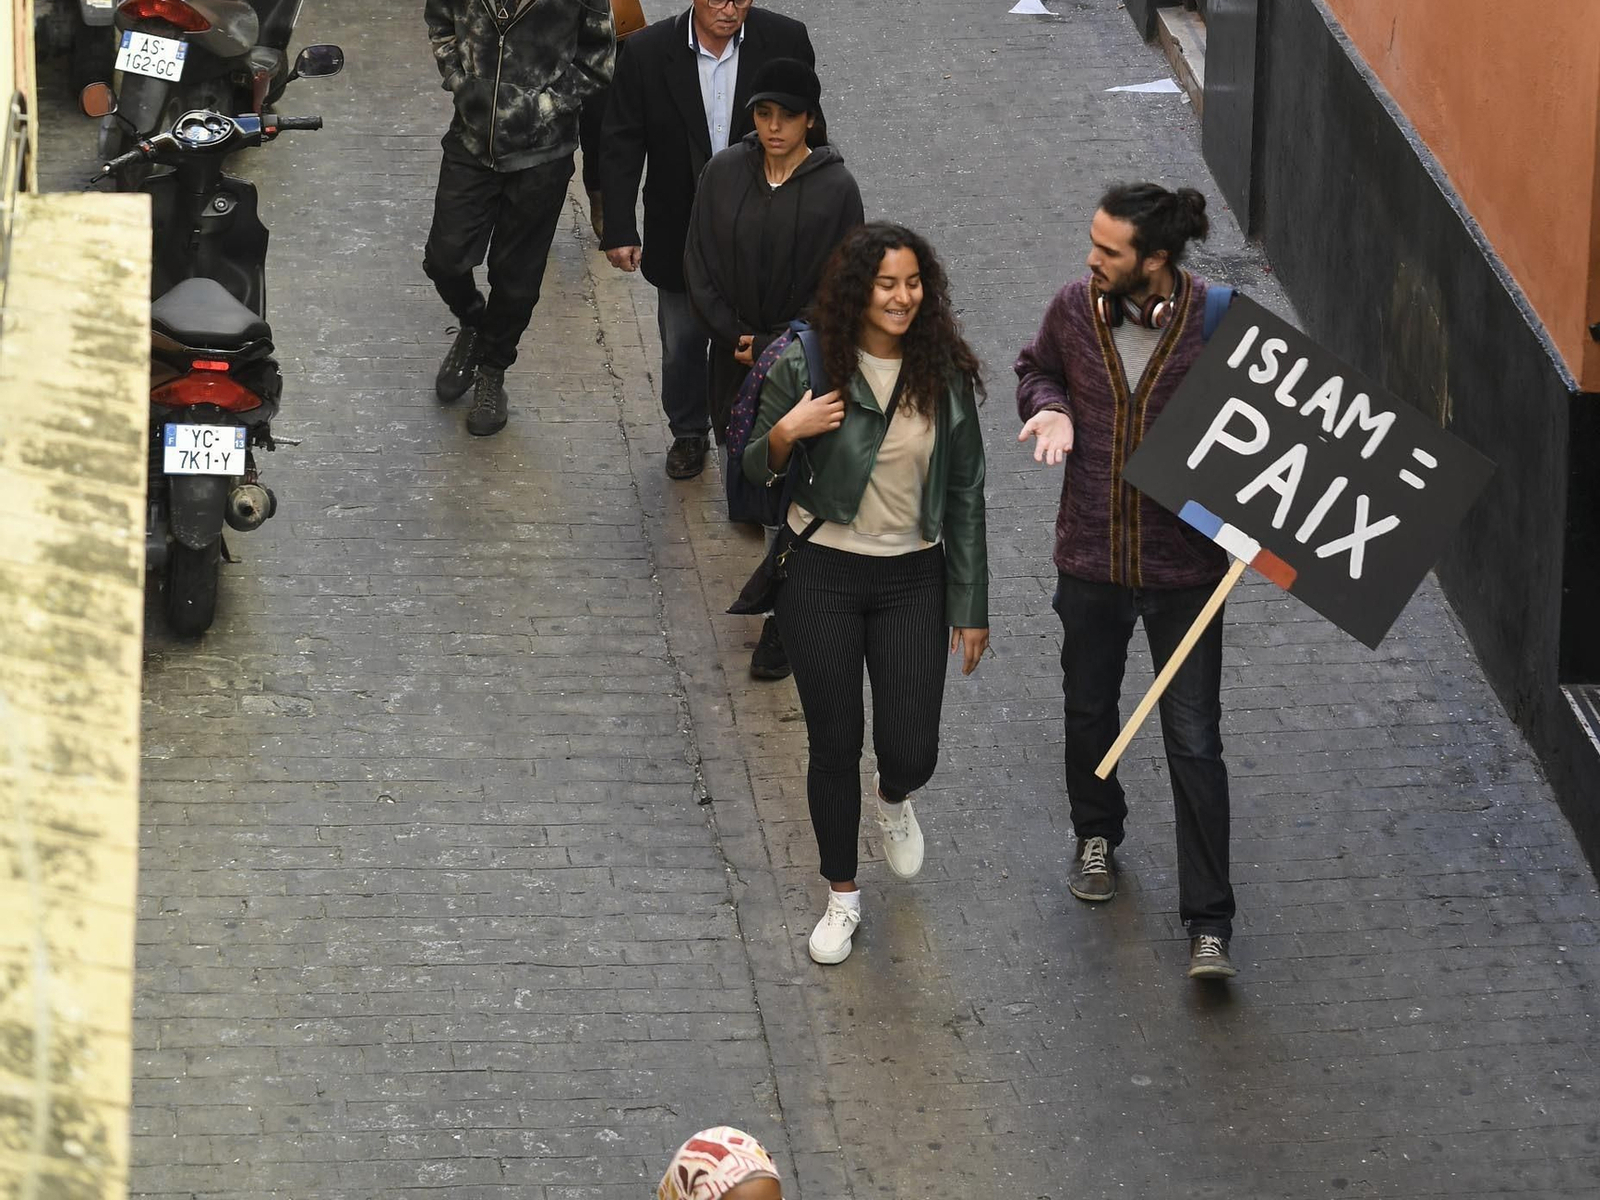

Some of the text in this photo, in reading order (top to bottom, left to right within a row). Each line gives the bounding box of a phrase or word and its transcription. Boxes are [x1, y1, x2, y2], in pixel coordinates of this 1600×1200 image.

[126, 53, 176, 76] 1G2-GC
[1226, 325, 1396, 459] ISLAM
[179, 450, 230, 470] 7K1-Y
[1186, 397, 1400, 580] PAIX
